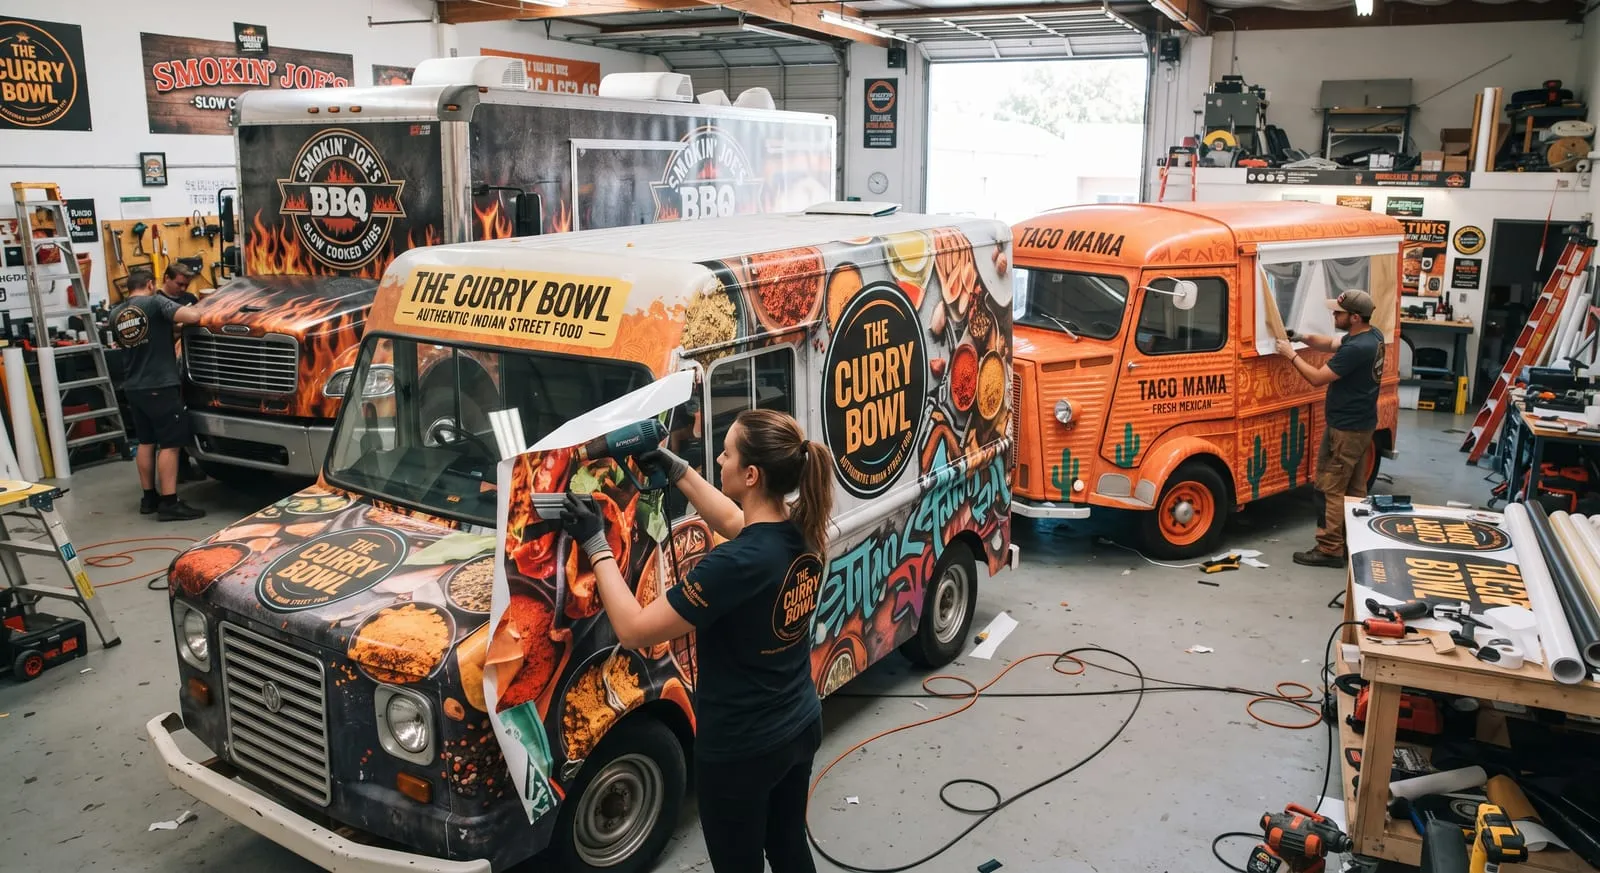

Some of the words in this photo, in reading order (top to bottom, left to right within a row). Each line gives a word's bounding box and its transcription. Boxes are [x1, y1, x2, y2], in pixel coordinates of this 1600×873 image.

[10, 43, 37, 59] THE
[153, 57, 276, 92] SMOKIN'
[1, 82, 58, 104] BOWL
[195, 95, 226, 110] SLOW
[299, 137, 347, 182] SMOKIN'
[348, 143, 382, 183] JOE'S
[669, 138, 717, 192] SMOKIN'
[310, 186, 368, 222] BBQ
[680, 184, 735, 220] BBQ
[303, 222, 325, 250] SLOW
[326, 244, 361, 260] COOKED
[362, 223, 381, 251] RIBS
[1018, 227, 1064, 249] TACO
[1063, 230, 1125, 257] MAMA
[410, 271, 455, 305] THE
[454, 273, 538, 313] CURRY
[536, 281, 612, 322] BOWL
[416, 307, 470, 326] AUTHENTIC
[470, 314, 507, 330] INDIAN
[509, 317, 550, 335] STREET
[552, 322, 583, 340] FOOD
[863, 318, 889, 349] THE
[834, 340, 914, 408] CURRY
[1138, 377, 1178, 400] TACO
[1183, 374, 1227, 397] MAMA
[845, 390, 912, 455] BOWL
[1152, 402, 1177, 415] FRESH
[1179, 399, 1212, 412] MEXICAN
[299, 542, 389, 578] CURRY
[348, 538, 381, 555] THE
[276, 560, 352, 595] BOWL
[783, 571, 821, 610] CURRY
[796, 567, 809, 584] THE
[1405, 557, 1472, 601] BOWL
[784, 594, 816, 627] BOWL
